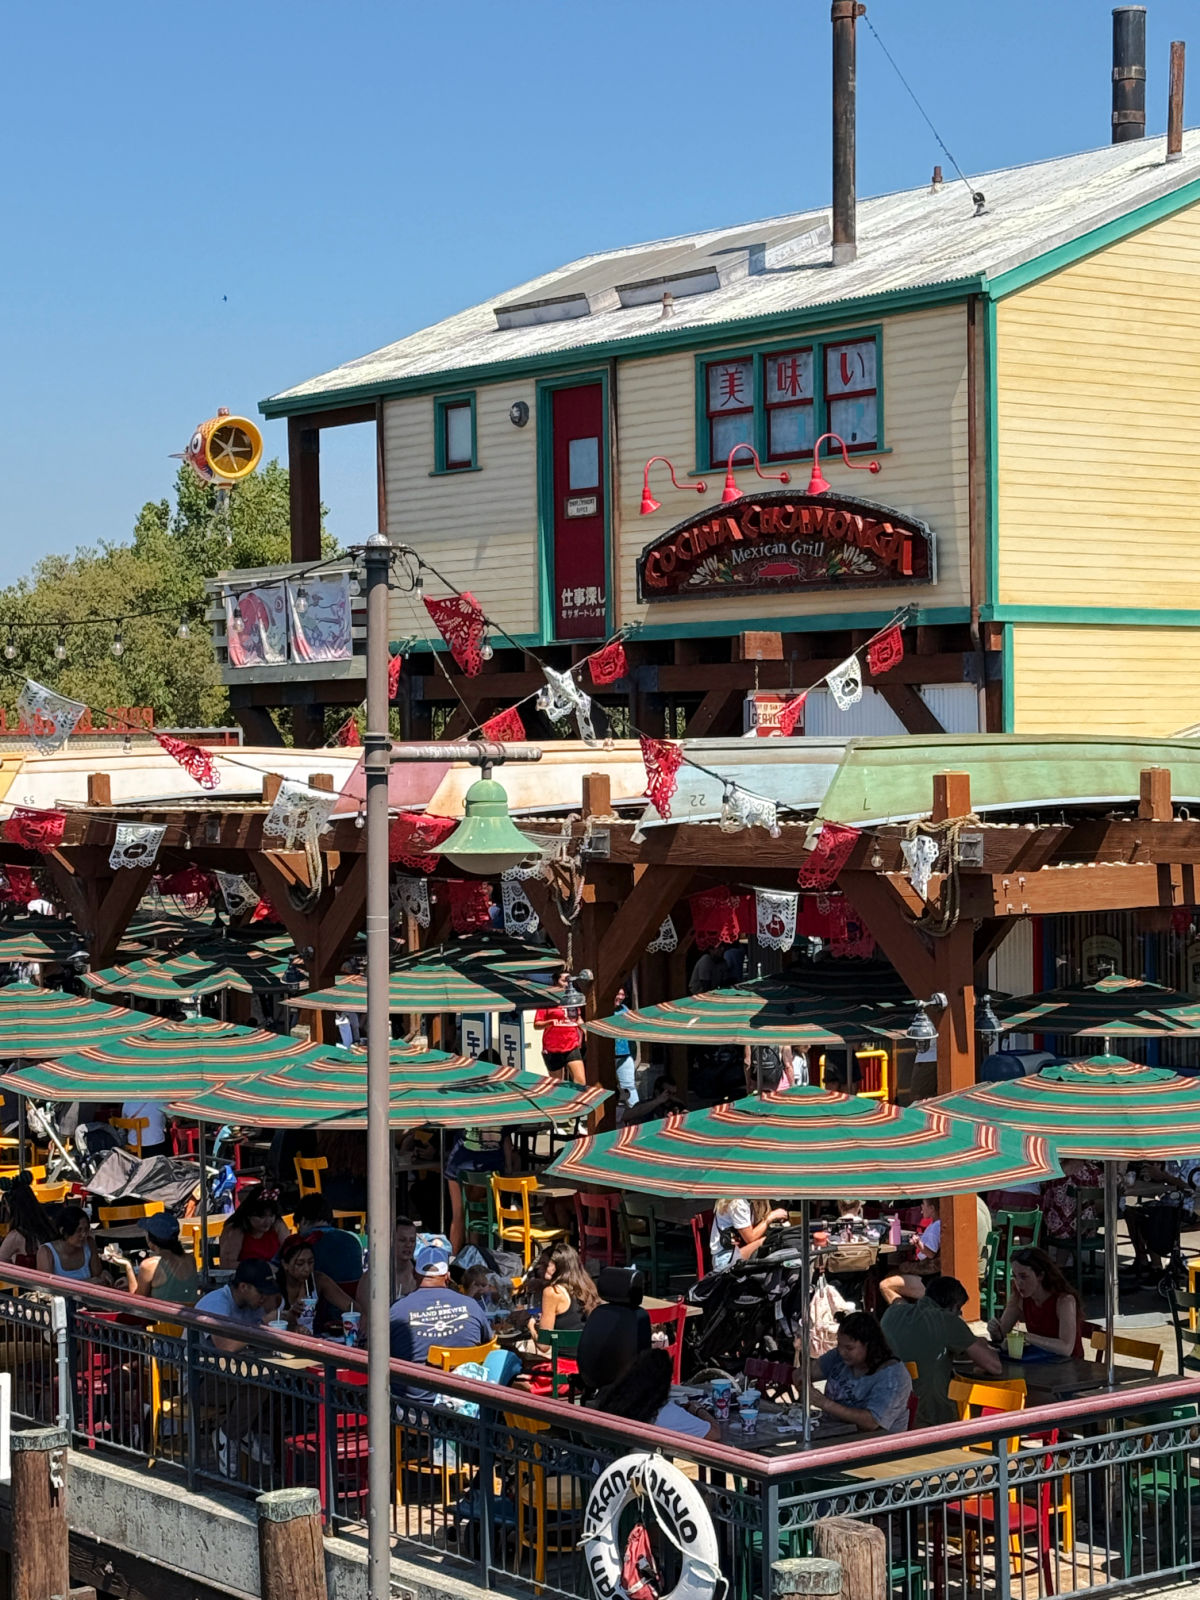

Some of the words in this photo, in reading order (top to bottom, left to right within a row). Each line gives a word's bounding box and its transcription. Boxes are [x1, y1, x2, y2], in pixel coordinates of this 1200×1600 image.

[645, 516, 743, 587] COCINA
[731, 542, 788, 565] Mexican
[791, 540, 825, 558] Grill
